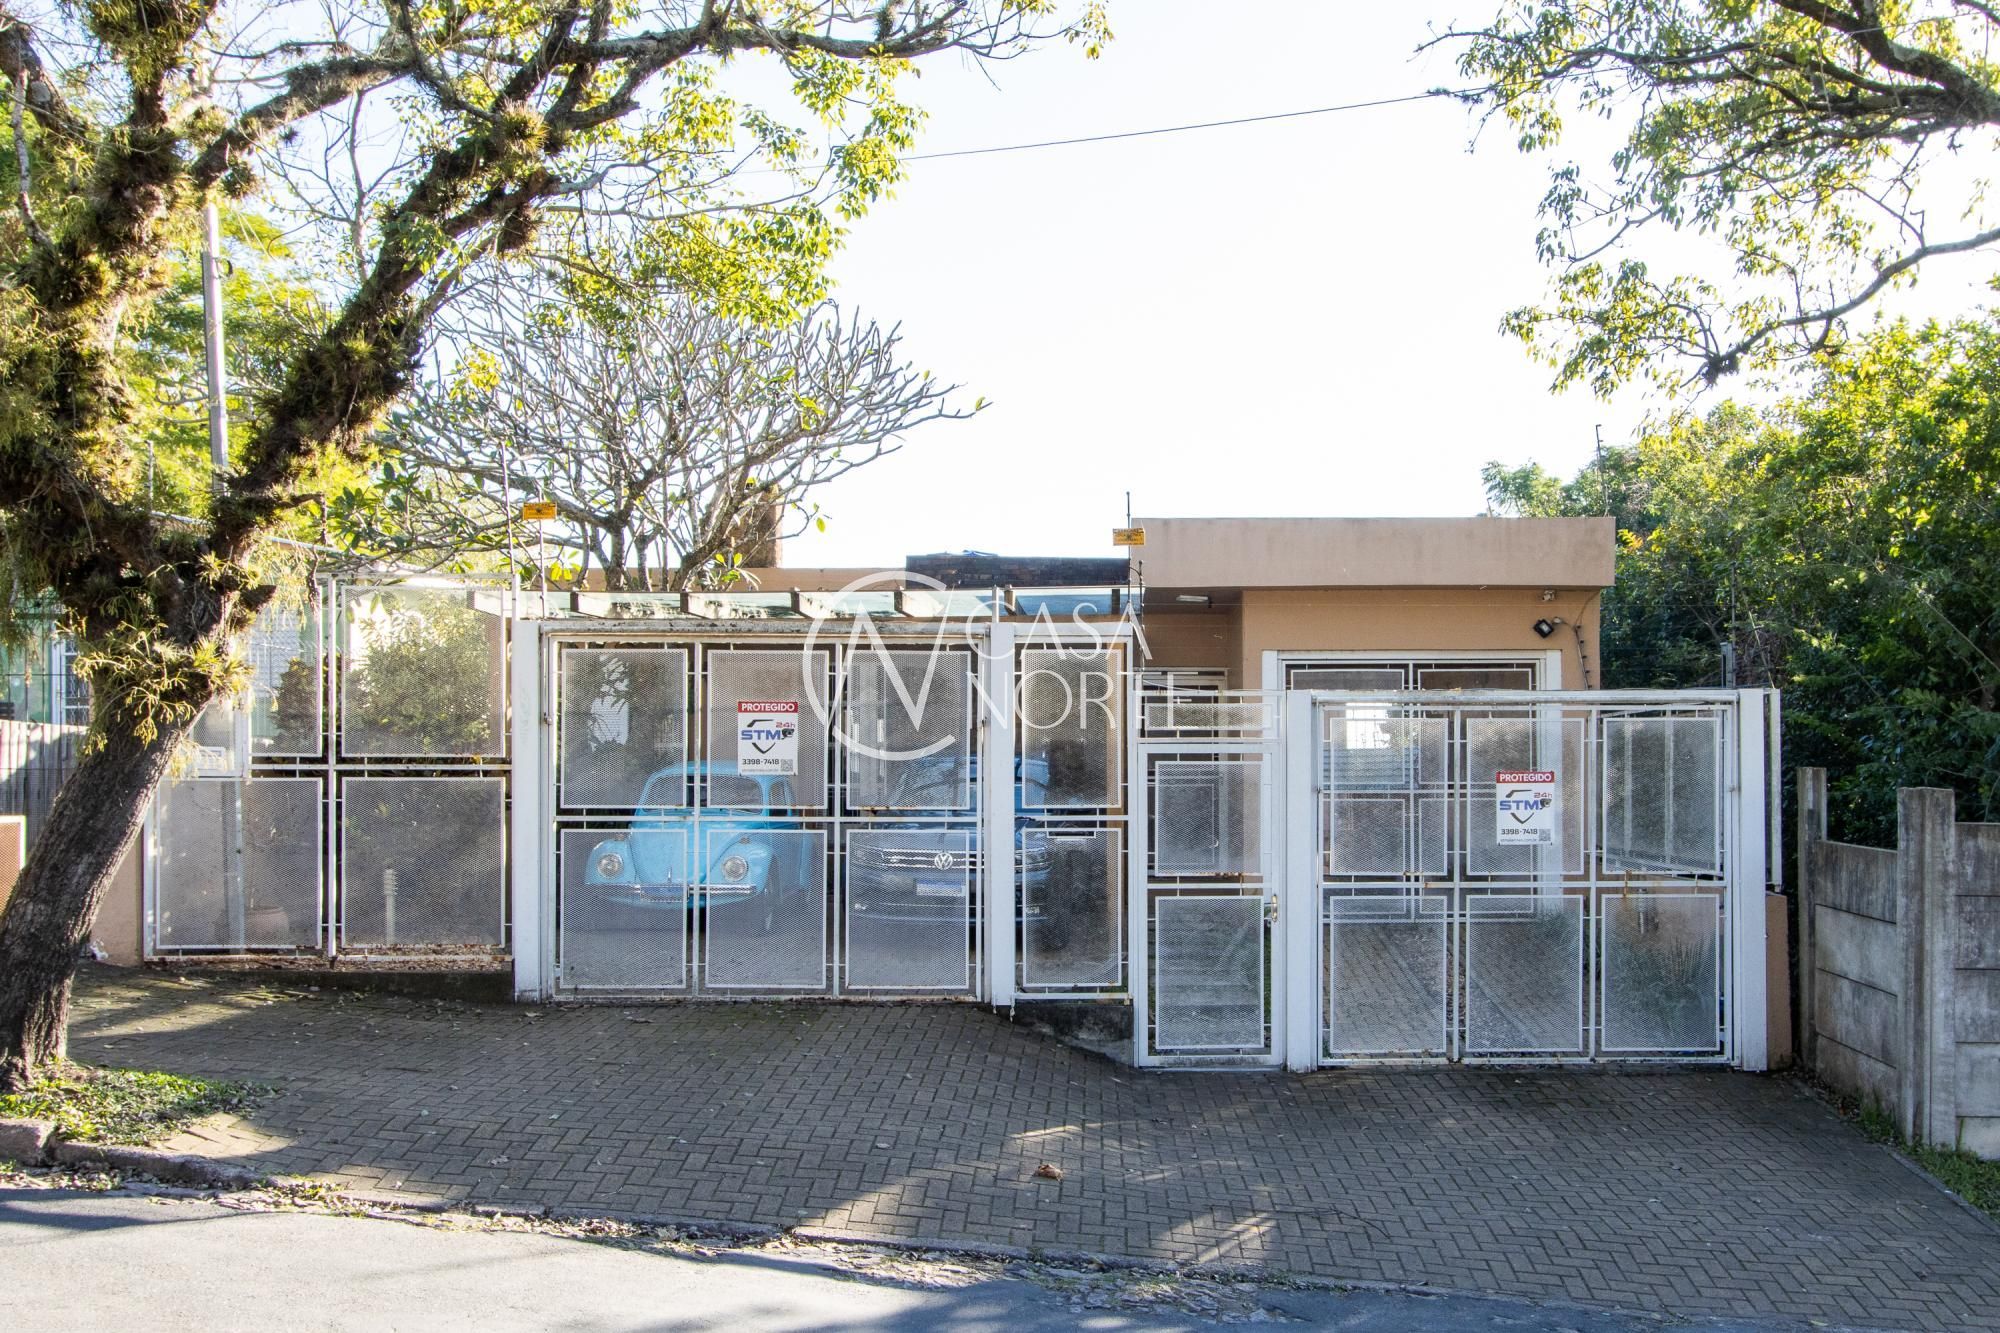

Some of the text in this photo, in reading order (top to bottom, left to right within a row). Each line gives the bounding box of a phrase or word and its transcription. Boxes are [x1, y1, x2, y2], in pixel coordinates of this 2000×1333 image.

[742, 703, 795, 711] PROTEGIDO
[741, 730, 781, 740] STM
[1500, 773, 1551, 781] PROTEGIDO
[1499, 800, 1540, 810] STM
